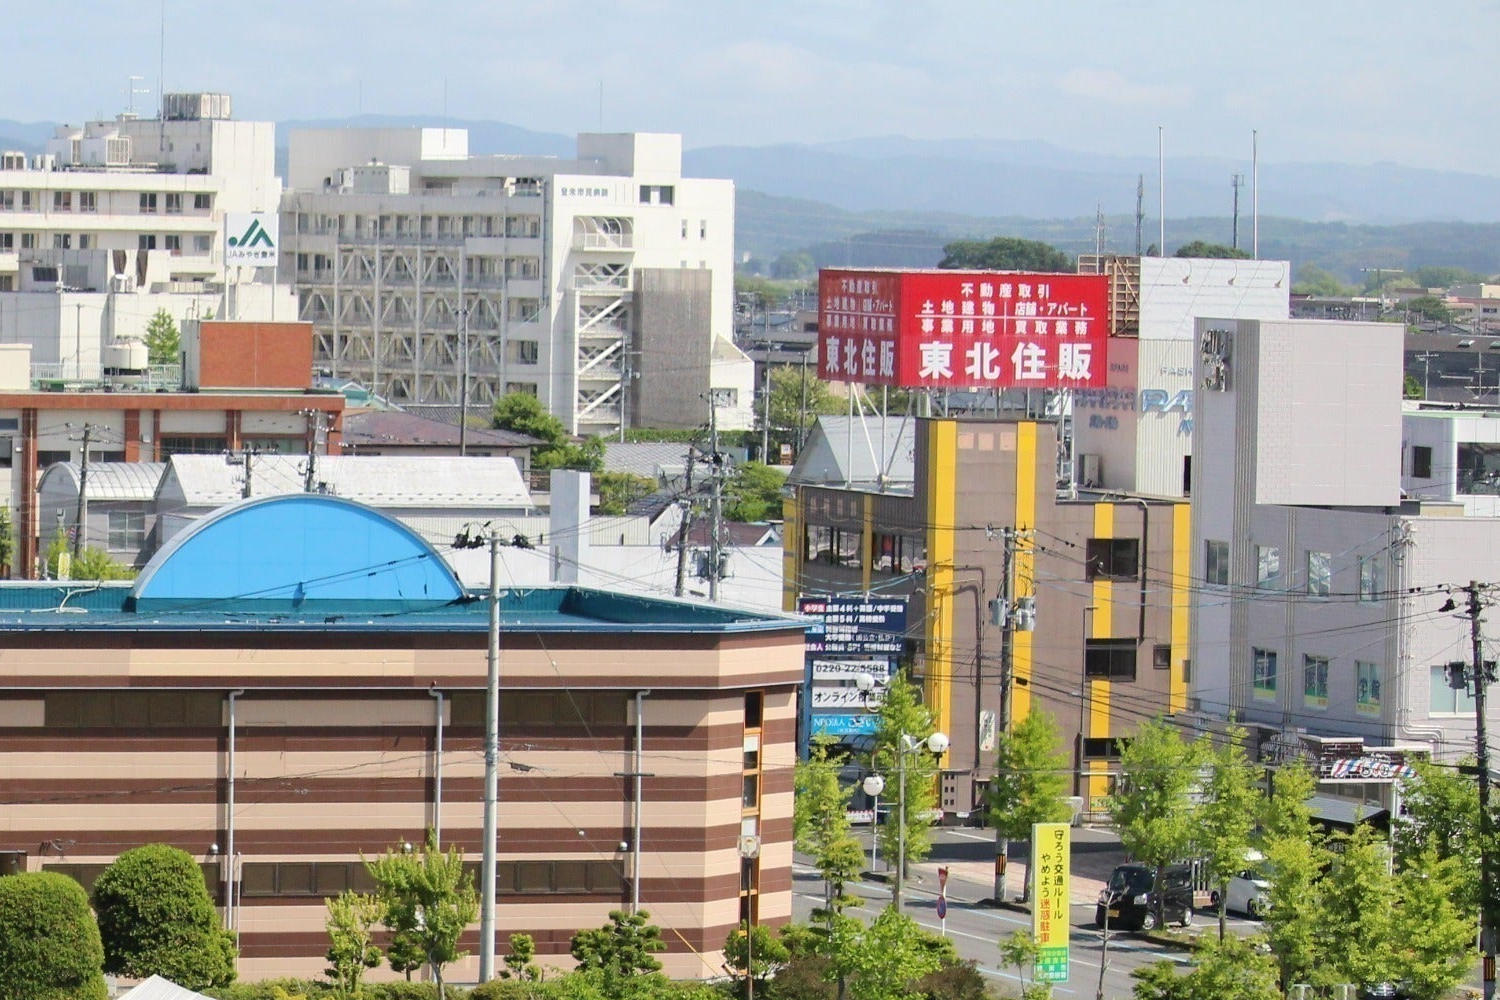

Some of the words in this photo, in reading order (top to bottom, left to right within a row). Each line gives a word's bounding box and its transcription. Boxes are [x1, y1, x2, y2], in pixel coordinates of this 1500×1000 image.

[961, 282, 1050, 299] 不動産取引
[921, 300, 995, 316] 土地建物
[1014, 302, 1088, 317] 店舗・アパート
[921, 318, 995, 334] 事業用地
[1015, 320, 1088, 335] 買取業務
[825, 335, 895, 378] 東北住販
[918, 340, 1092, 381] 東北住販
[1053, 829, 1064, 920] 守ろう交通ルール
[1040, 852, 1051, 944] やめよう迷惑駐車
